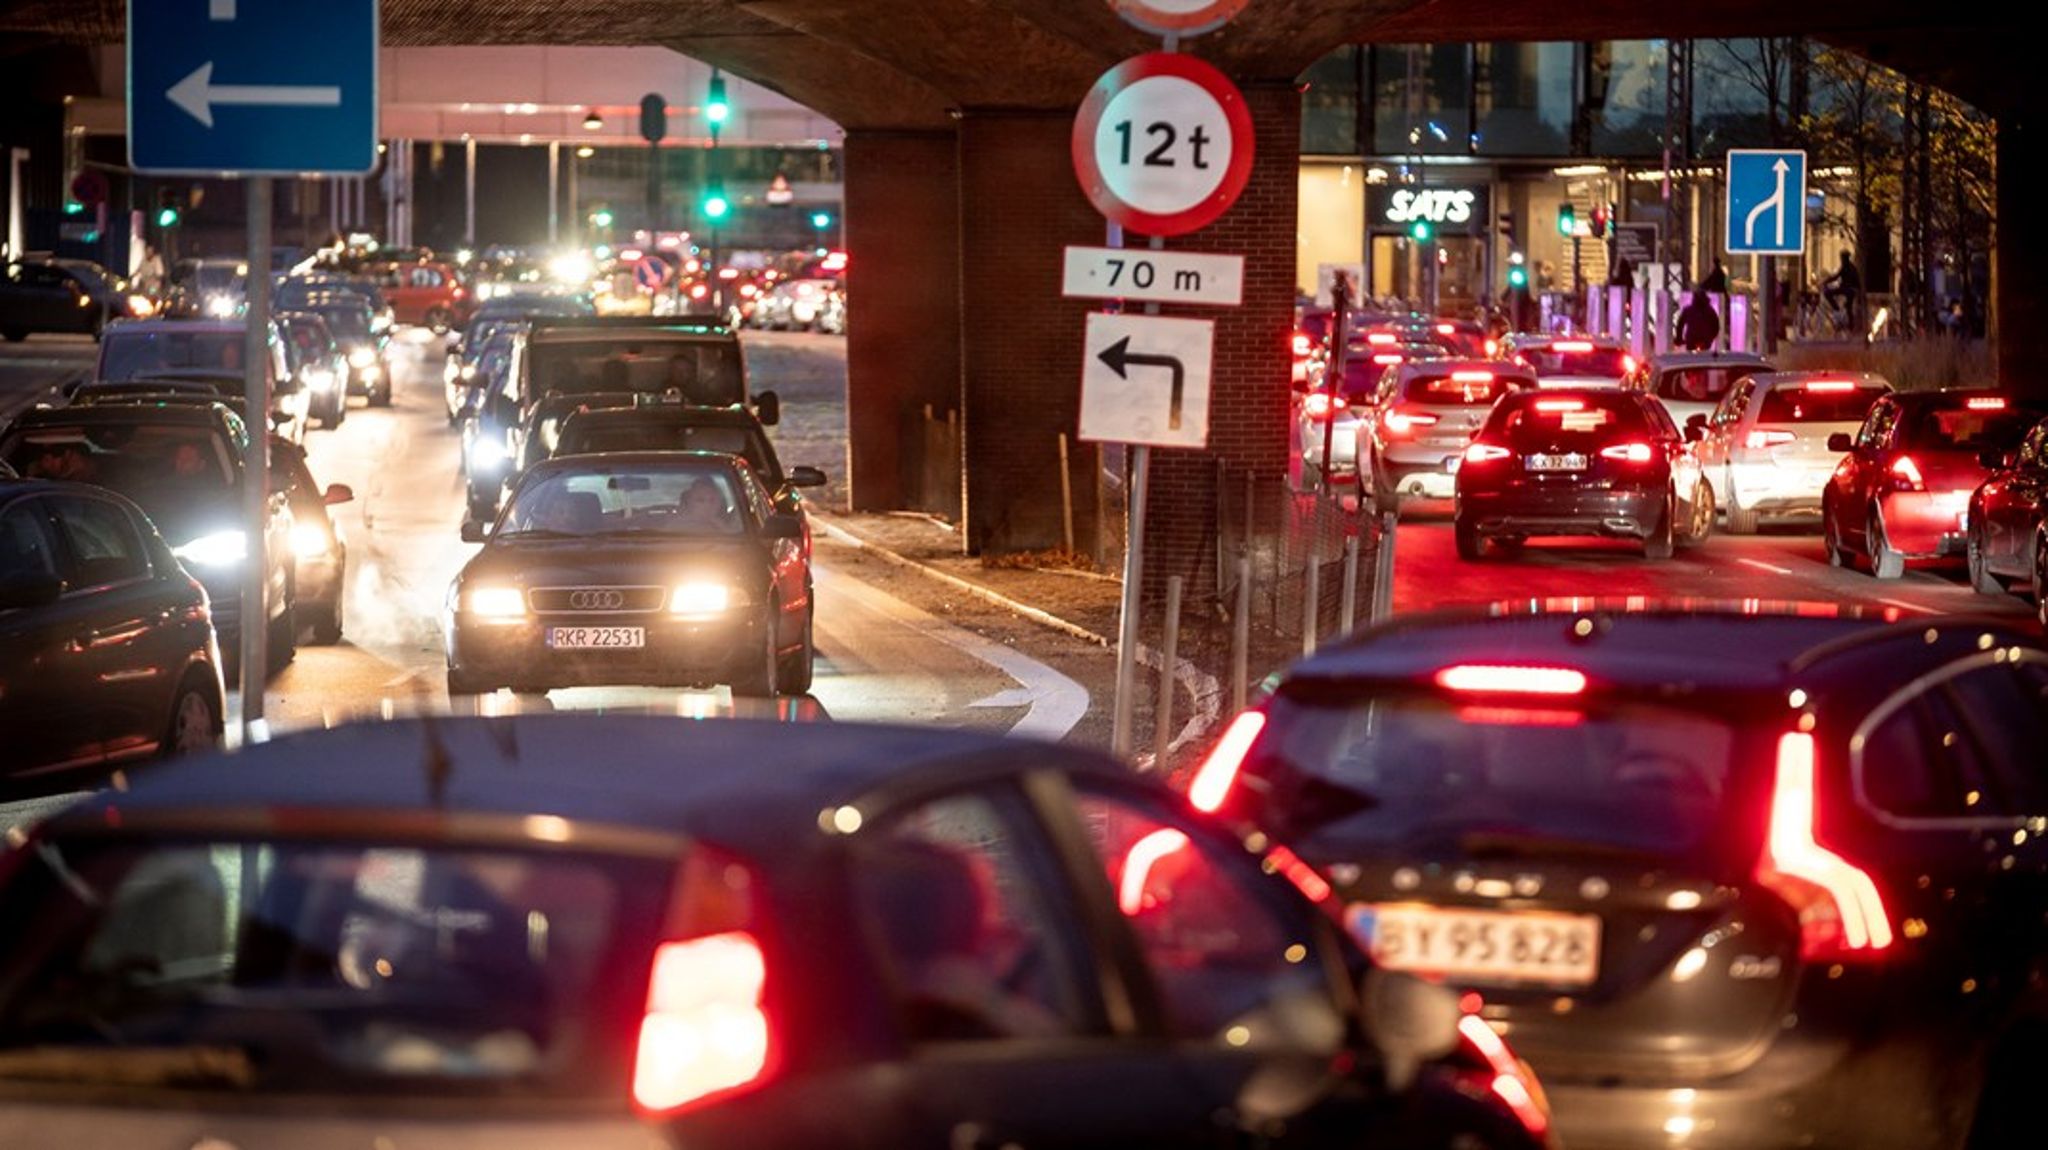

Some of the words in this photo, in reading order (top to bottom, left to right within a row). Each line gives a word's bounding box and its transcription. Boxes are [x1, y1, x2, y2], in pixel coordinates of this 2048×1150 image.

[1385, 188, 1475, 222] SATS
[1106, 259, 1155, 289] 70
[1174, 268, 1201, 291] m
[554, 629, 586, 645] RKR
[591, 628, 640, 645] 22531
[1448, 922, 1497, 961] 95
[1511, 925, 1587, 965] 828
